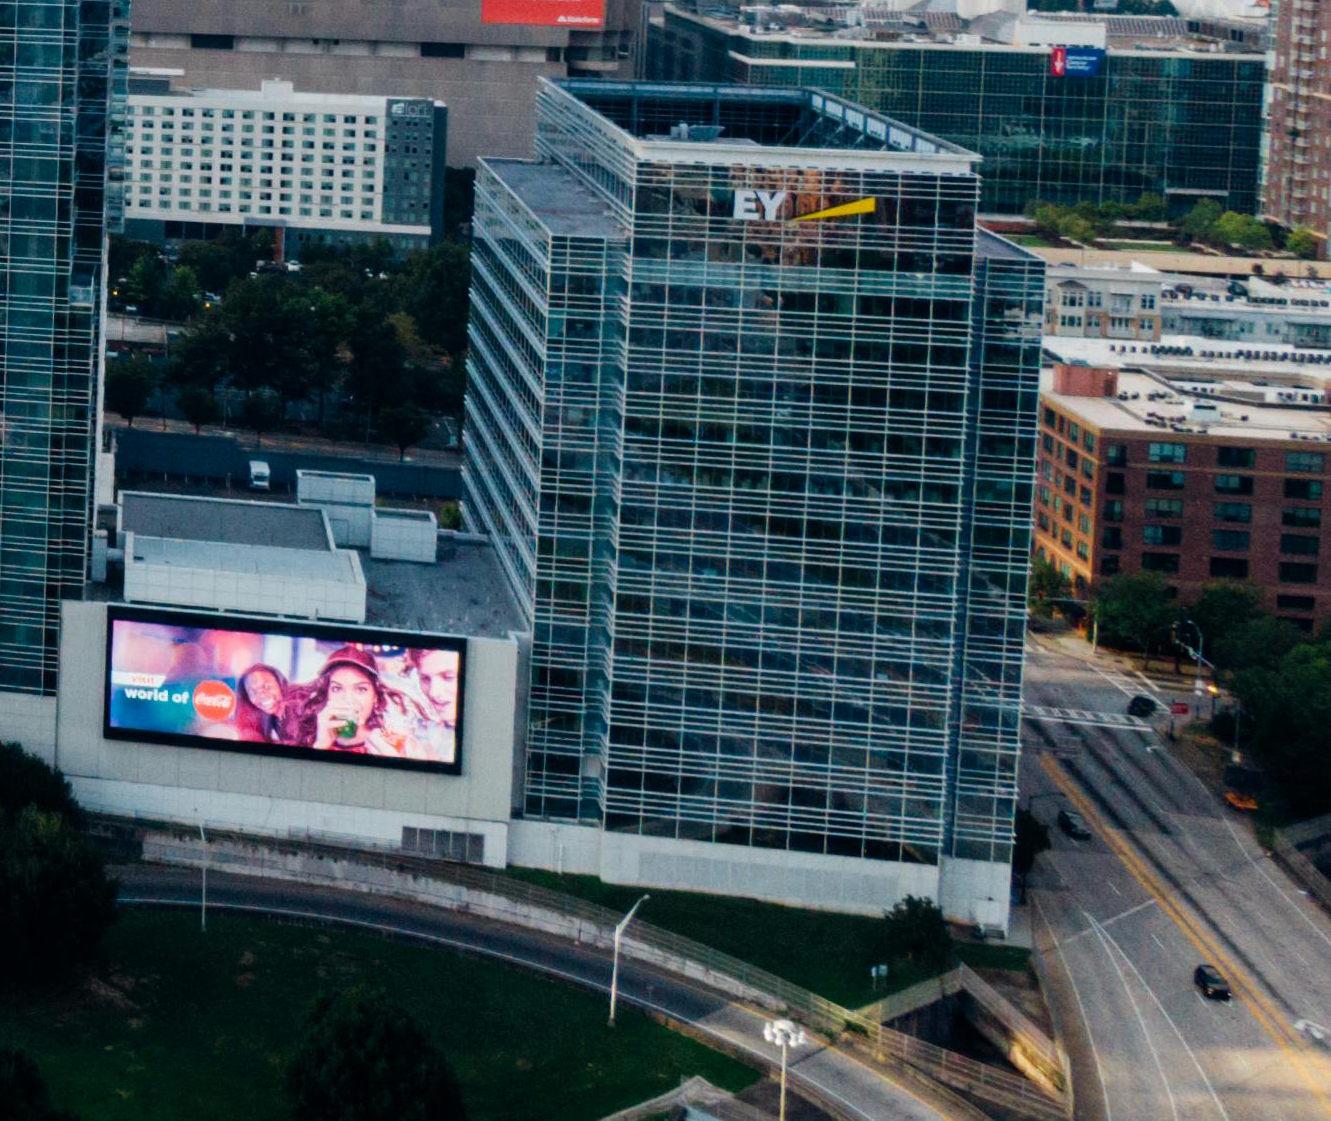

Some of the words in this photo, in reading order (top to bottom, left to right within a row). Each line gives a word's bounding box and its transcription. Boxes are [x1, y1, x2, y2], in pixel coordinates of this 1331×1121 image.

[733, 190, 786, 221] EY
[124, 688, 169, 702] world
[171, 691, 189, 704] of
